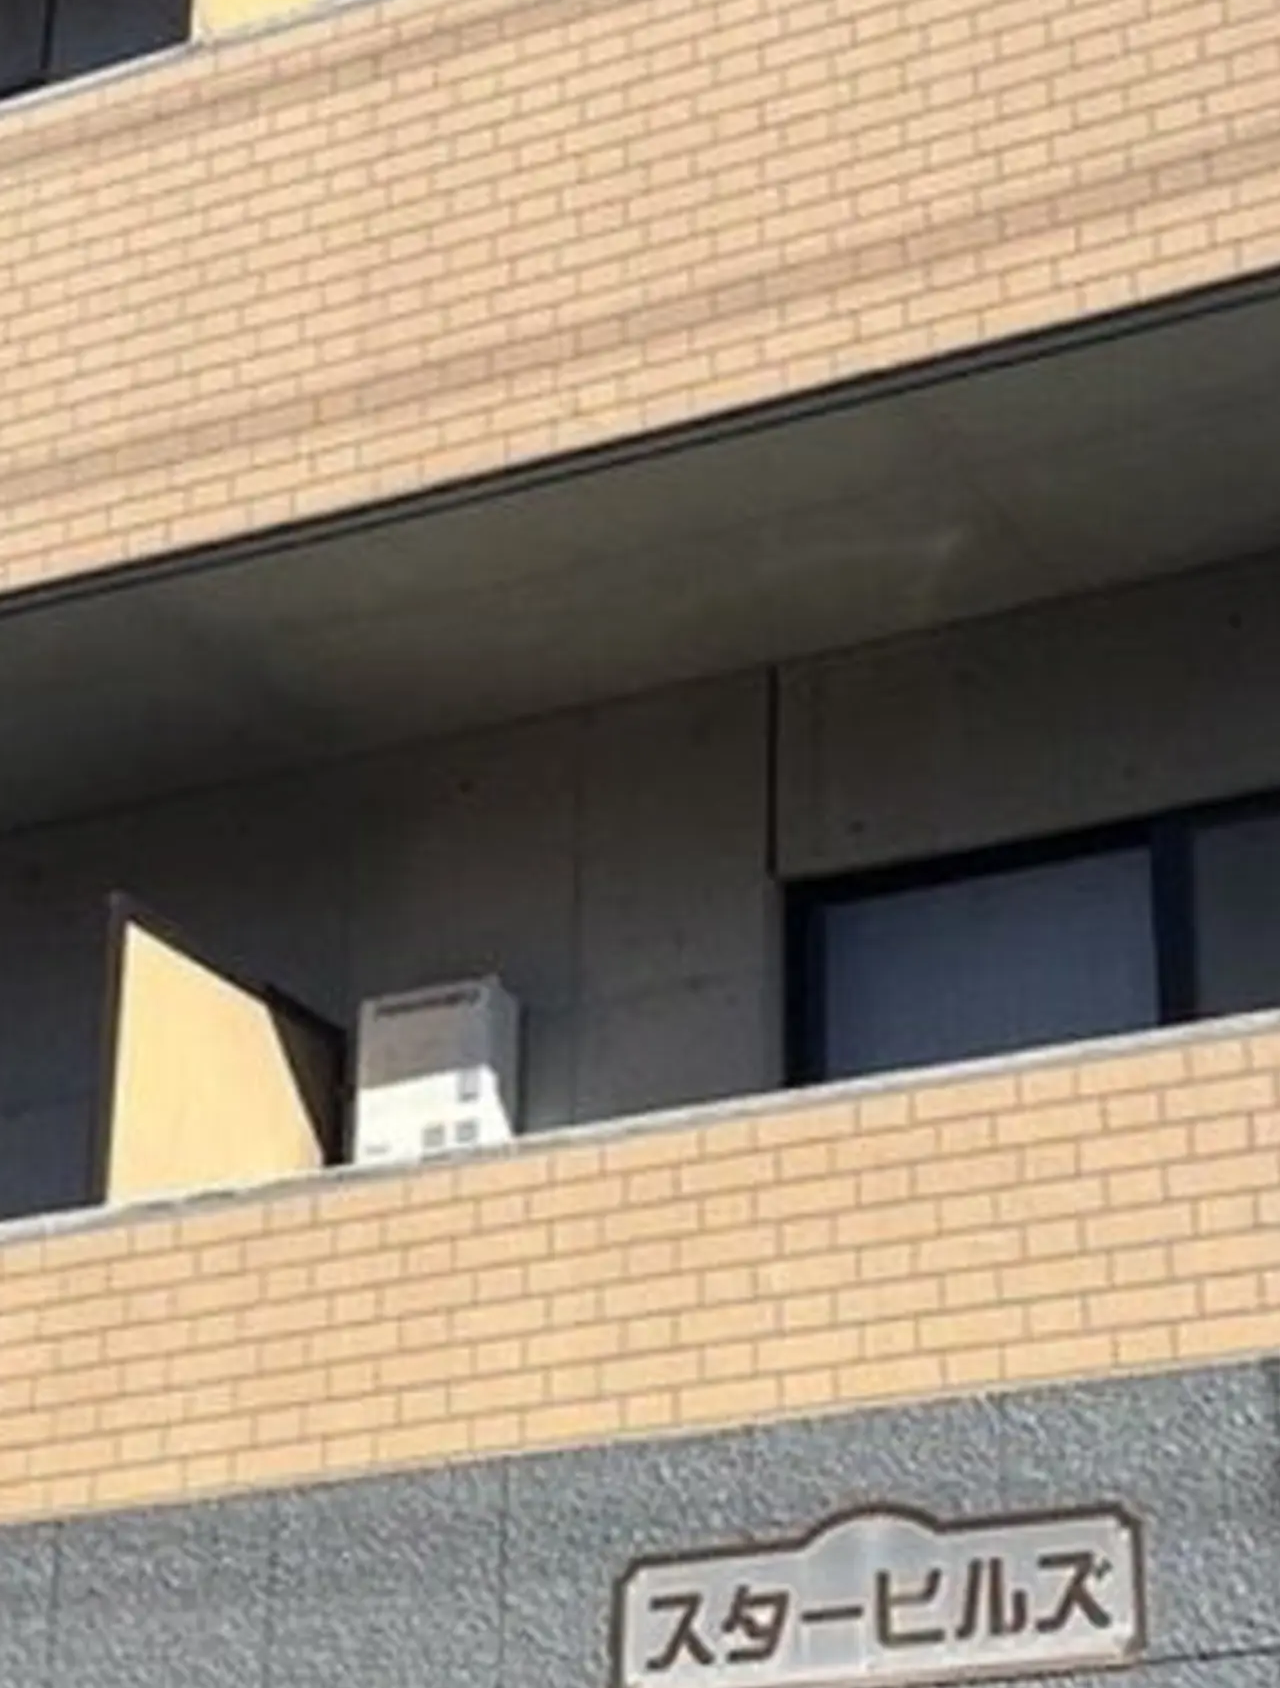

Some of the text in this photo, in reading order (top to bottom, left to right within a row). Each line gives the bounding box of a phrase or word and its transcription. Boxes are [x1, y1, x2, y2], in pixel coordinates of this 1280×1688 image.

[646, 1550, 1113, 1672] スターヒルズ
